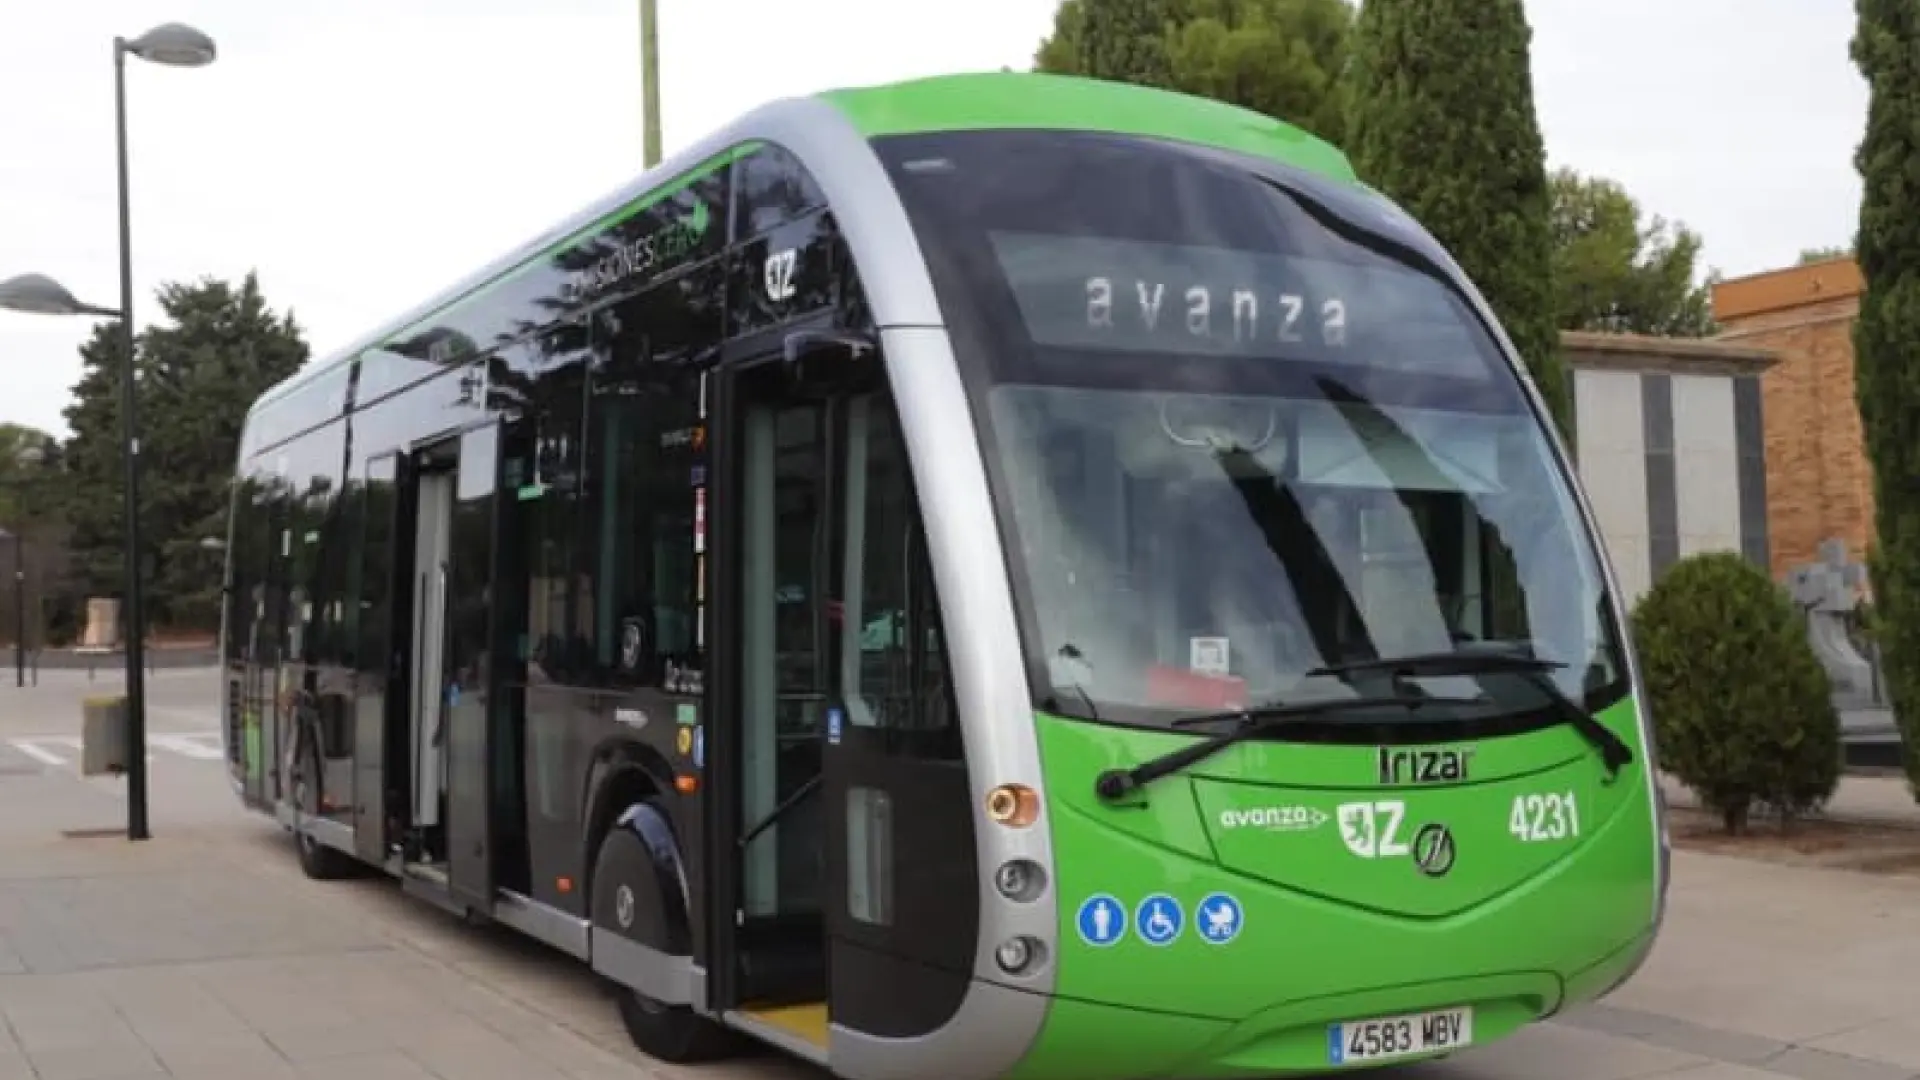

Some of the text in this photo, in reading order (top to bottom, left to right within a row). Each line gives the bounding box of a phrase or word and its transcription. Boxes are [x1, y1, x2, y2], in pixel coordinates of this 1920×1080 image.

[1085, 276, 1346, 347] avanza
[1378, 745, 1473, 784] Irizar
[1219, 805, 1308, 829] avanza
[1509, 791, 1580, 842] 4231
[1349, 1020, 1412, 1056] 4583
